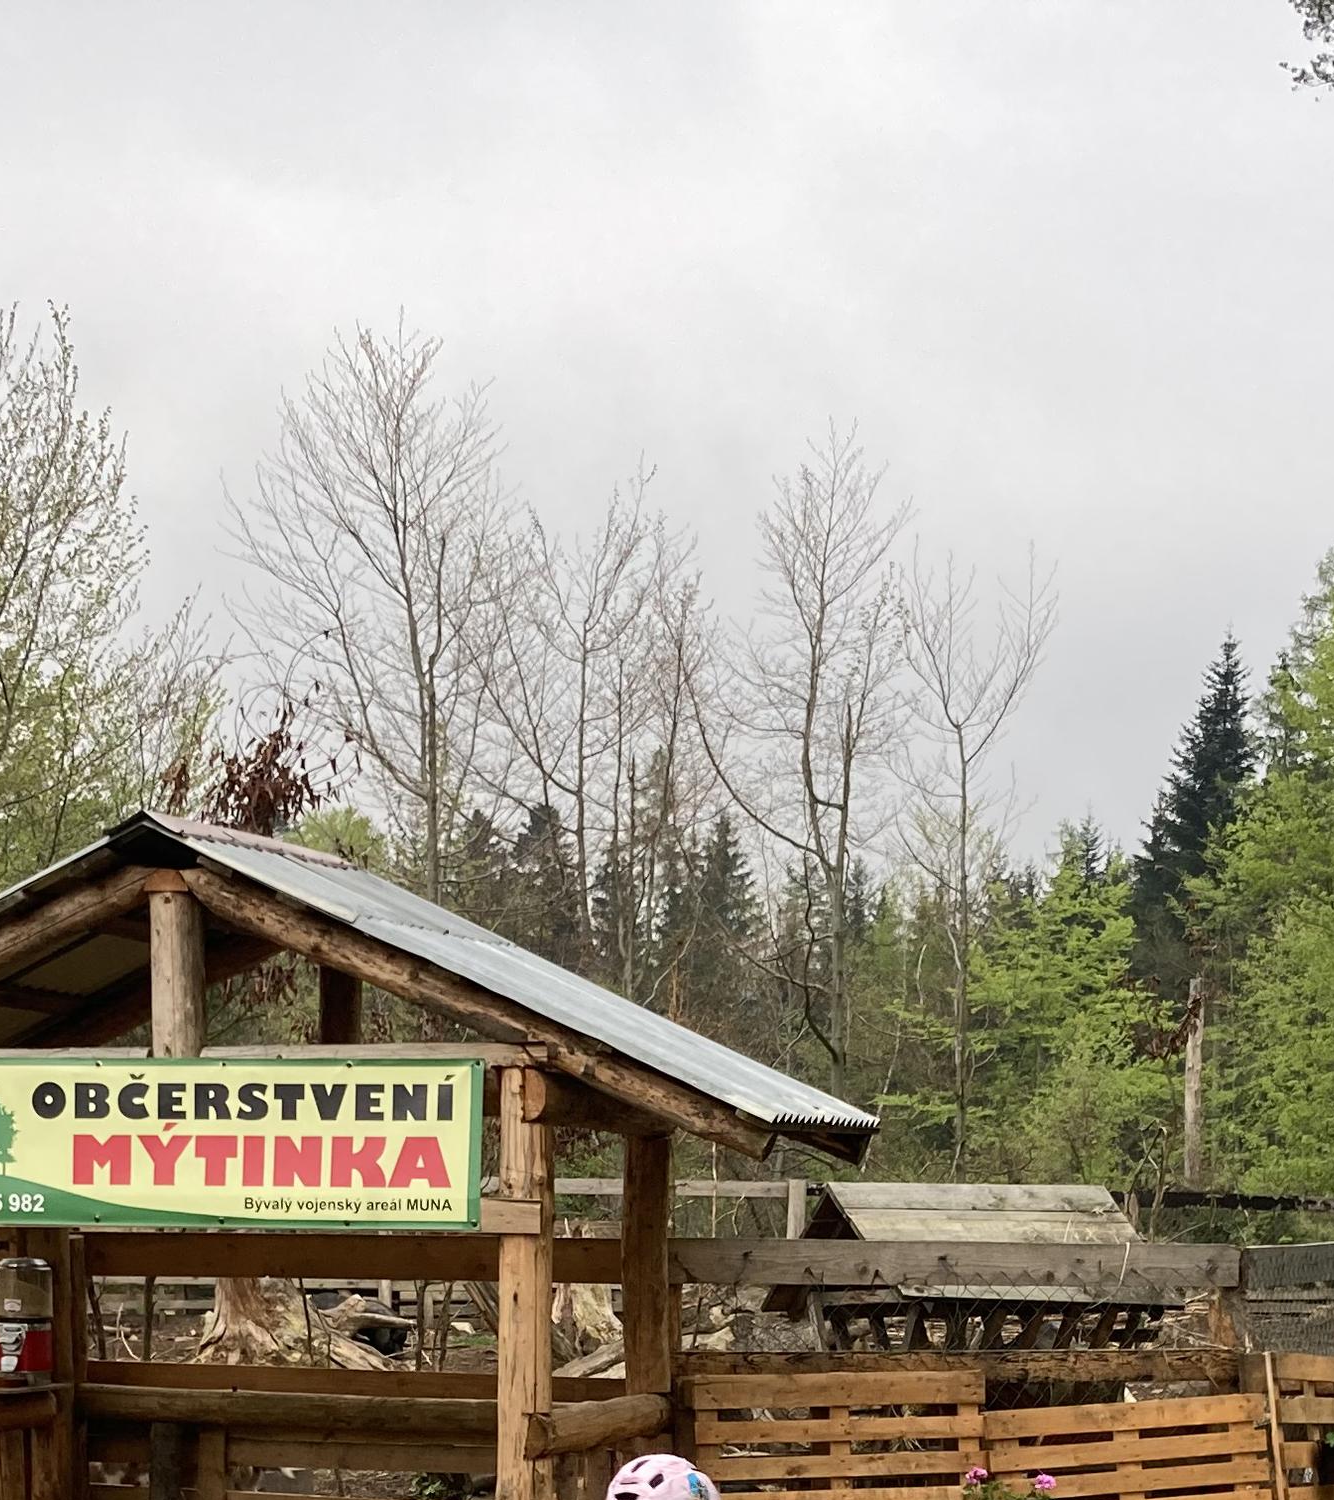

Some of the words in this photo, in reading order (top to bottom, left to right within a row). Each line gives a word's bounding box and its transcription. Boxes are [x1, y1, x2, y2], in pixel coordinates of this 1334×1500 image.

[31, 1073, 455, 1121] OBČERSTVENÍ
[72, 1122, 452, 1188] MÝTINKA
[8, 1193, 45, 1213] 982
[243, 1196, 293, 1213] Bývalý
[296, 1198, 362, 1214] vojenský
[366, 1198, 402, 1212] areál
[406, 1198, 453, 1212] MUNA
